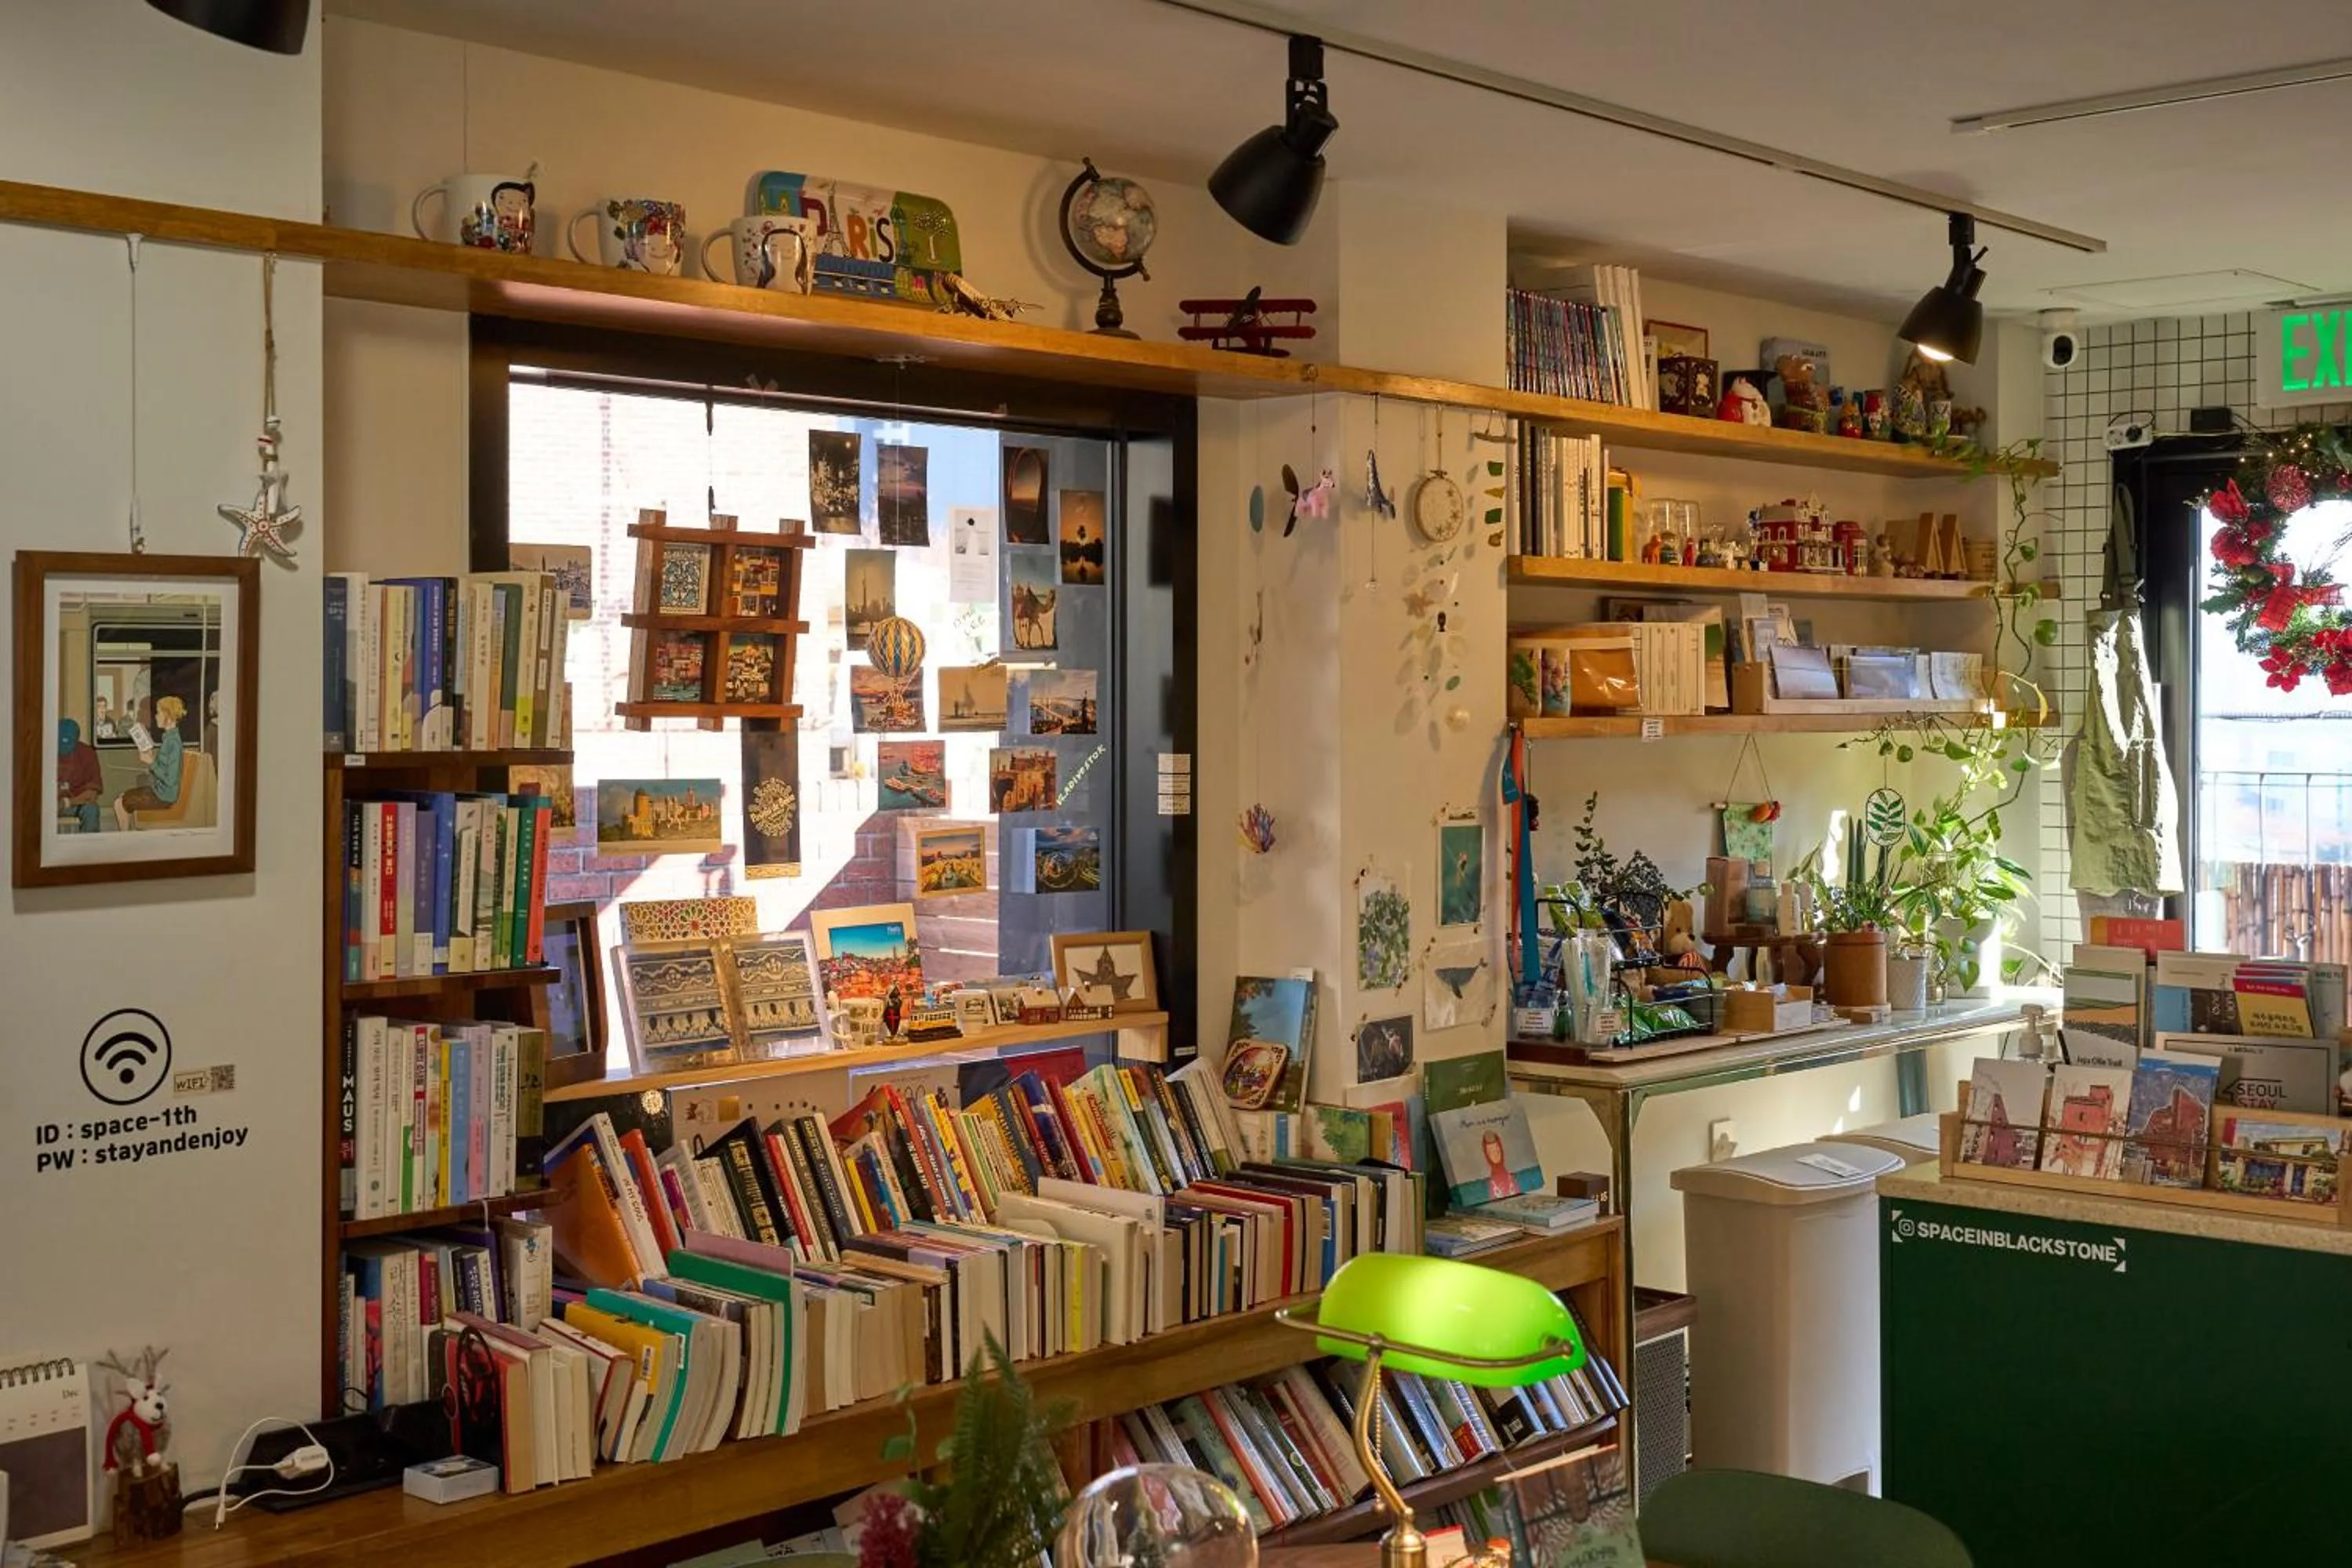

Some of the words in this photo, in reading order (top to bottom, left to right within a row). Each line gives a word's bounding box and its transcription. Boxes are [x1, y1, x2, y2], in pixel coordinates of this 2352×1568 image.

[343, 1075, 354, 1131] MAUS
[2237, 1082, 2287, 1098] SEOUL
[81, 1105, 197, 1140] space-1th
[95, 1127, 249, 1163] stayandenjoy
[1917, 1221, 2118, 1263] SPACEINBLACKSTONE
